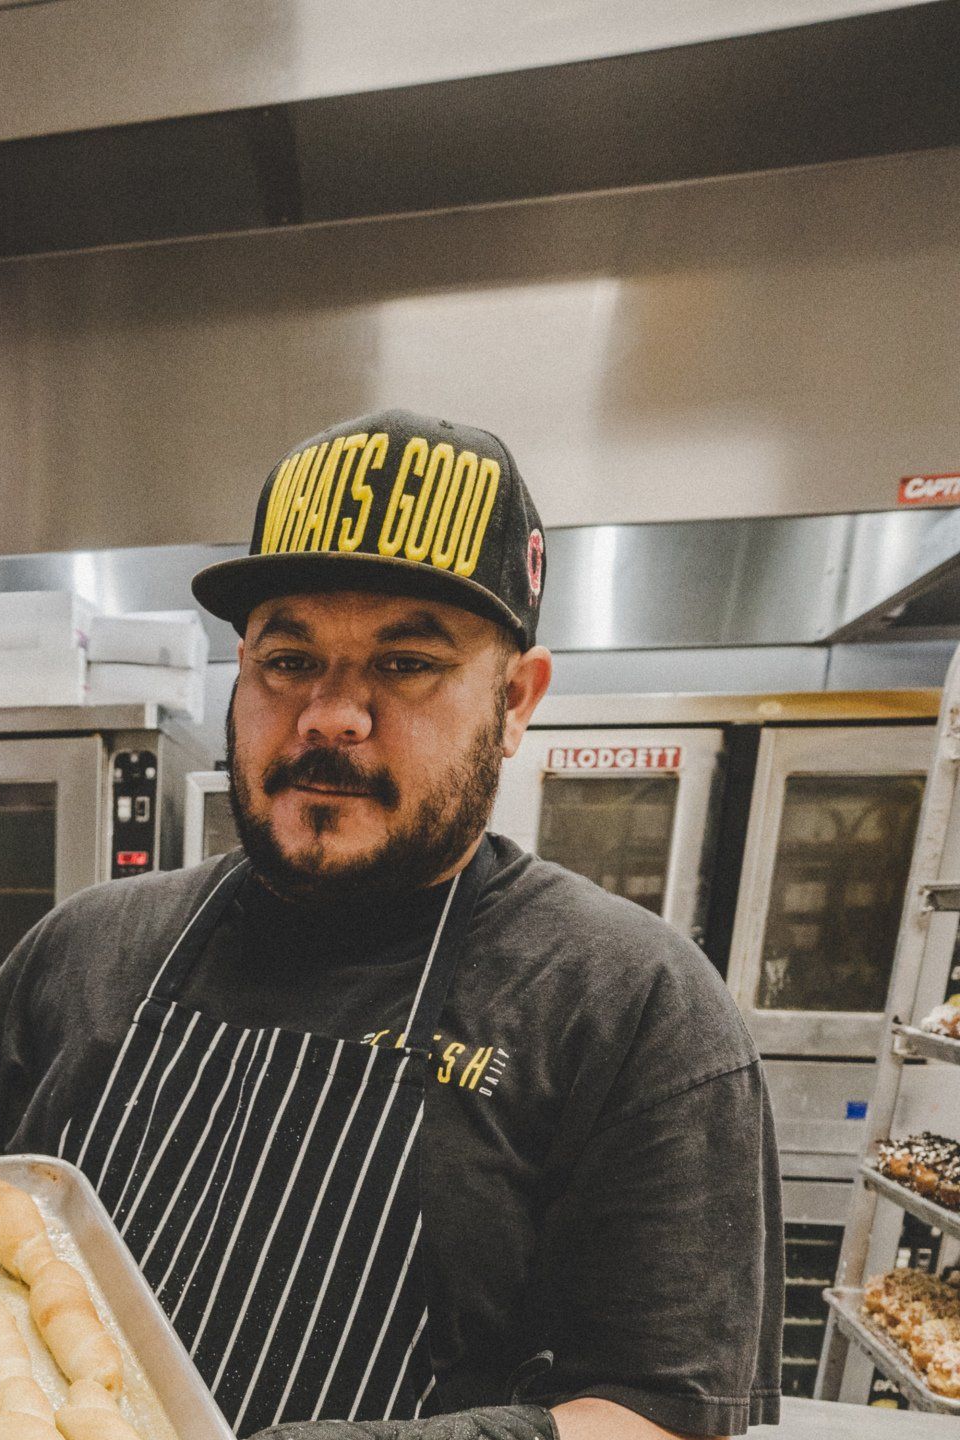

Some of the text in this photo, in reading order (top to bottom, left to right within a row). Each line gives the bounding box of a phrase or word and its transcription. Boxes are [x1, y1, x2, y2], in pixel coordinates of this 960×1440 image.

[261, 433, 501, 577] WHATS GOOD
[905, 477, 960, 499] CAPTI
[551, 748, 678, 768] BLODGETT
[479, 1048, 510, 1097] DAILY
